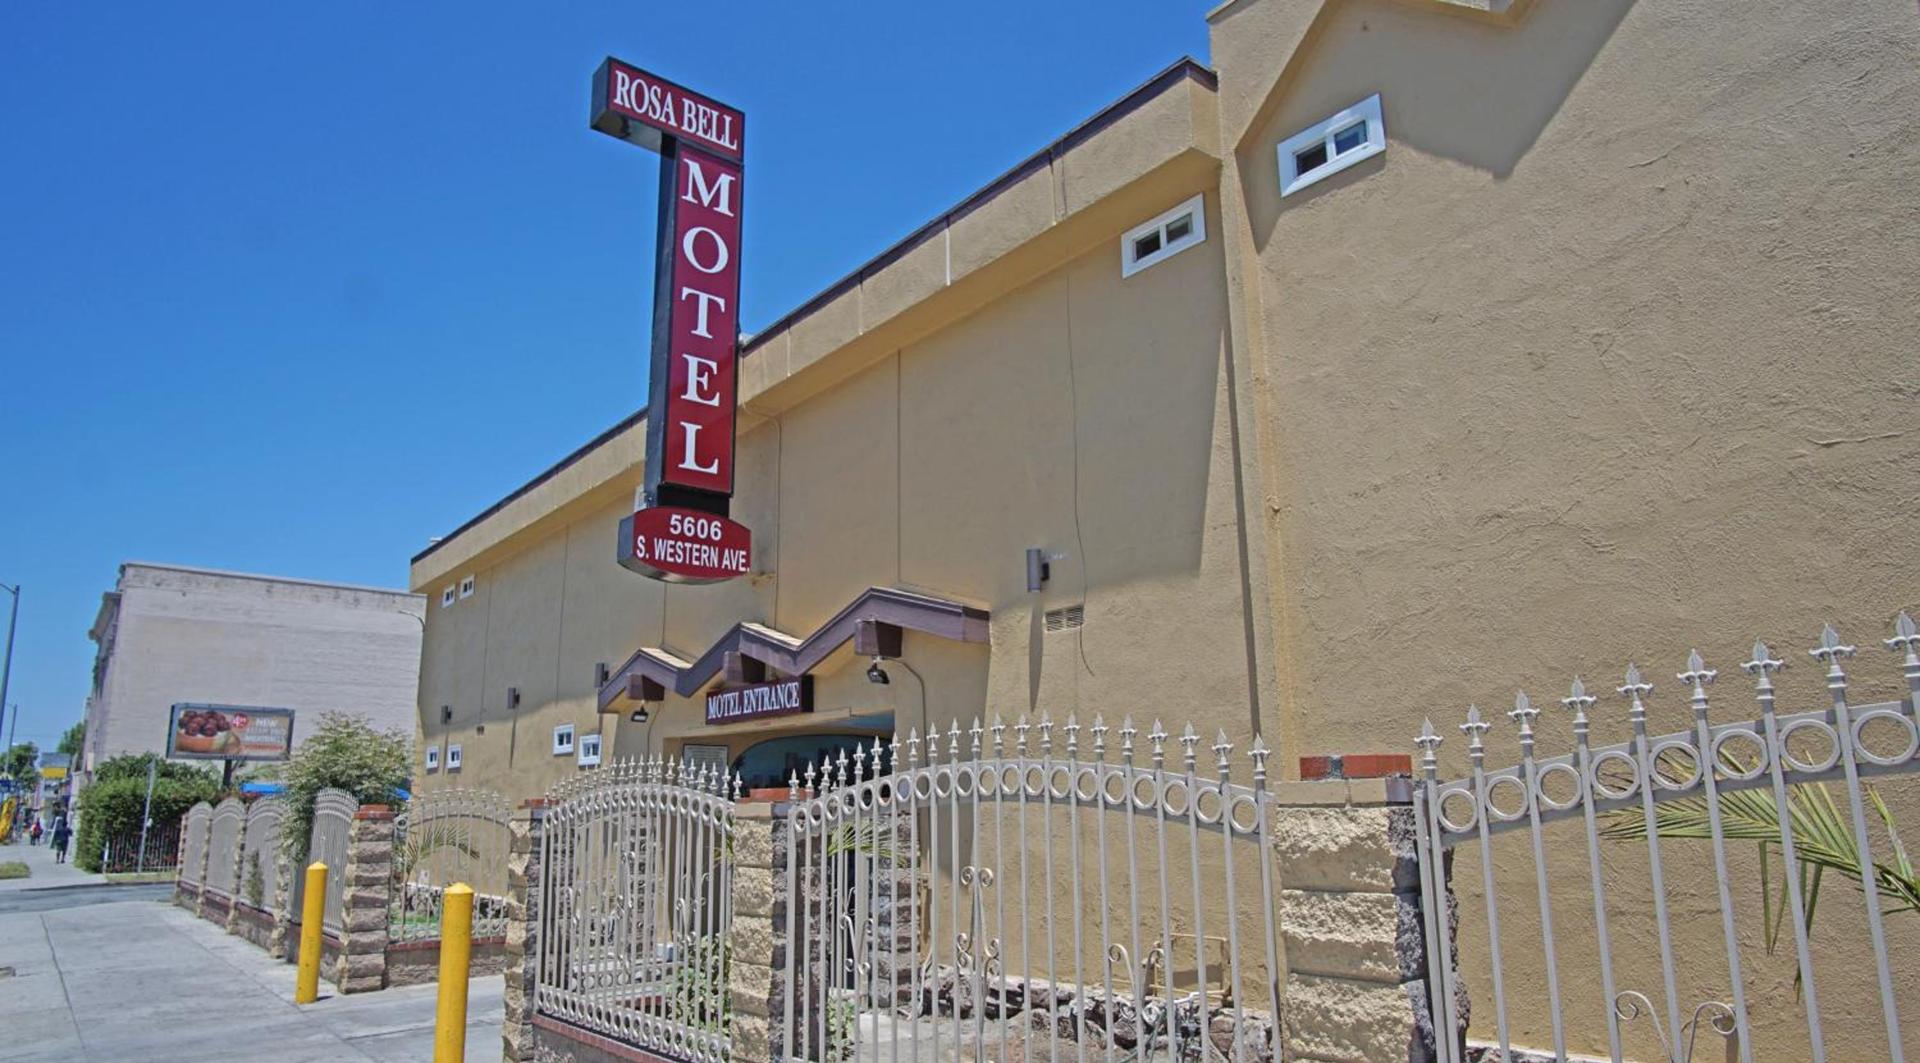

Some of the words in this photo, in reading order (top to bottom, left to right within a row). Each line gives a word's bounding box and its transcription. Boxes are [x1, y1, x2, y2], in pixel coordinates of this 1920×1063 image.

[613, 70, 678, 127] ROSA
[681, 98, 737, 150] BELL
[678, 158, 735, 475] MOTEL
[669, 513, 722, 541] 5606
[636, 535, 649, 559] S.
[654, 537, 718, 568] WESTERN
[721, 548, 750, 573] AVE.
[707, 692, 742, 719] MOTEL
[743, 682, 800, 714] ENTRANCE
